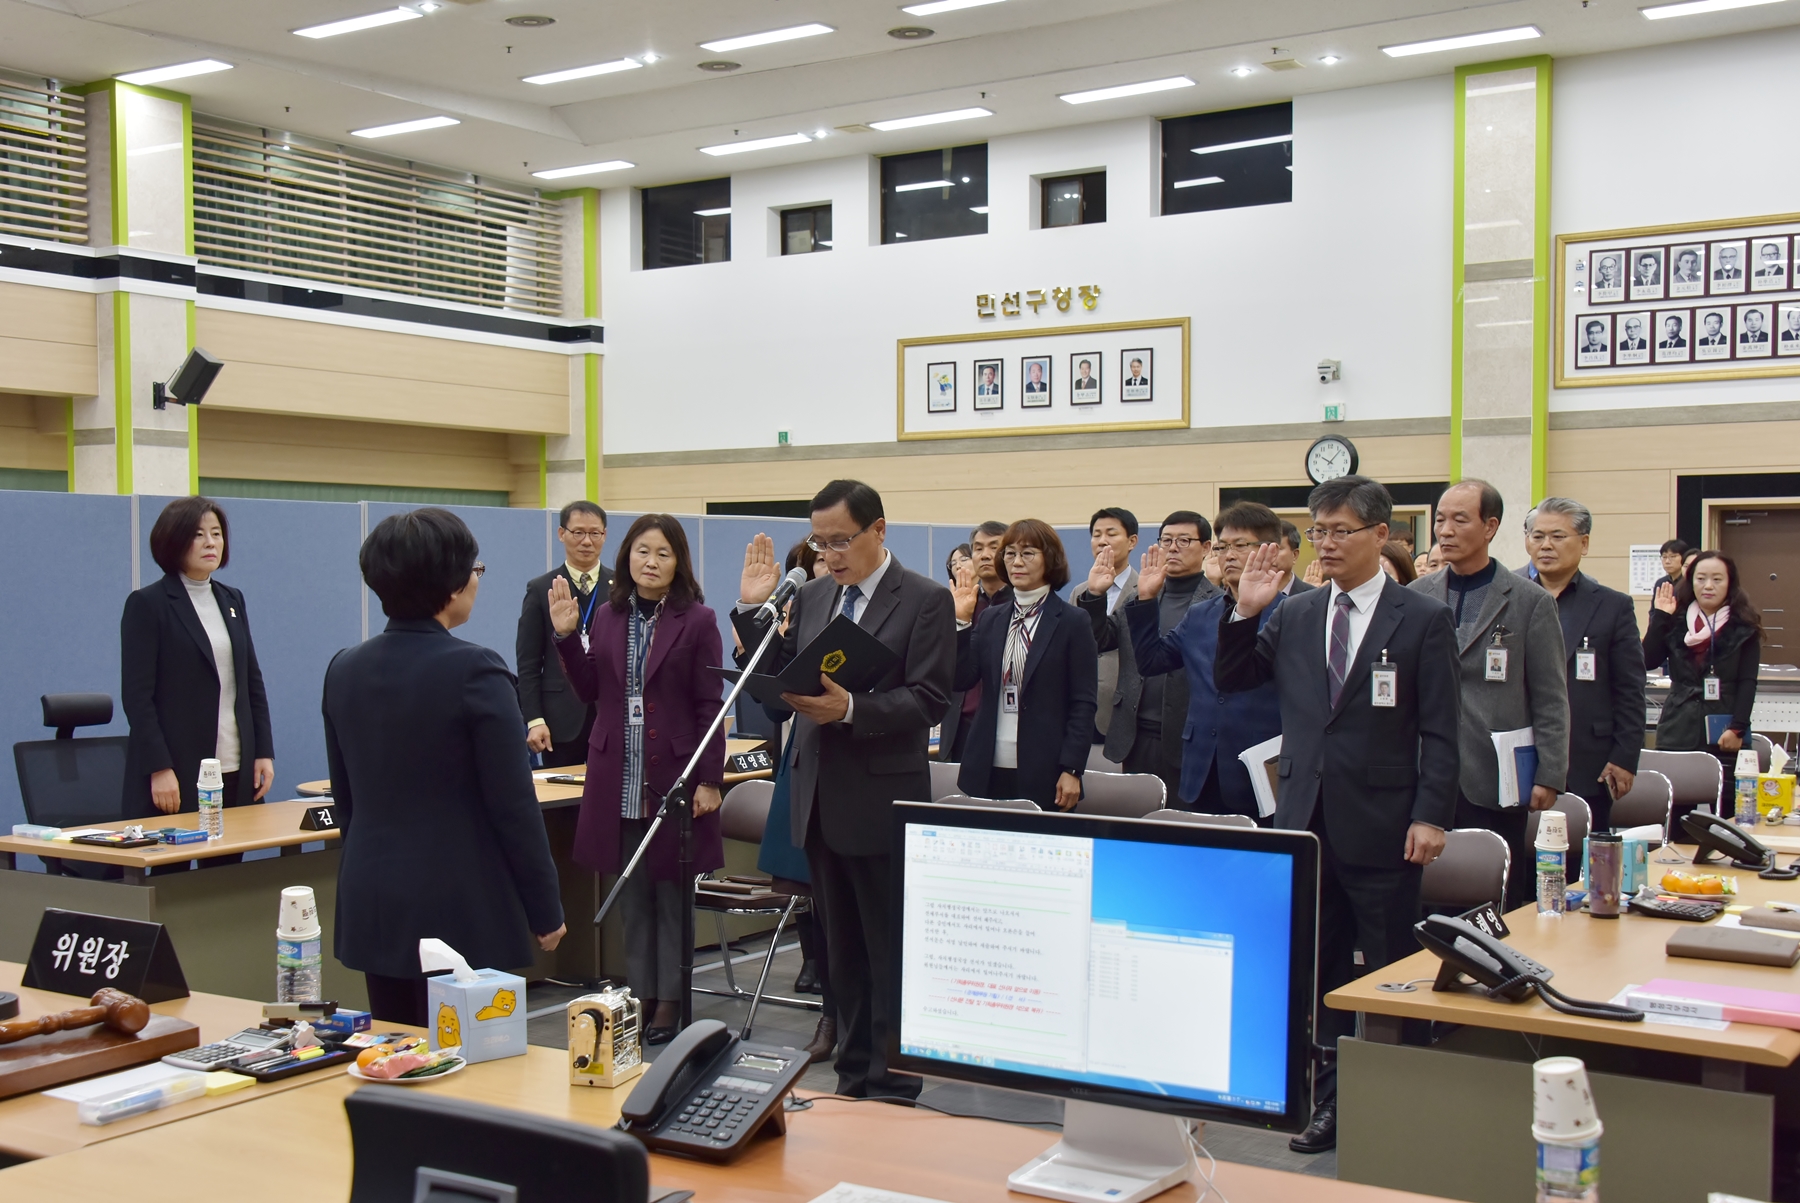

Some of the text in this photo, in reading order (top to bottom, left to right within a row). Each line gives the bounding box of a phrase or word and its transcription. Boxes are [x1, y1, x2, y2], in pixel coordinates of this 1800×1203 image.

[976, 285, 1102, 318] 민선구청장
[737, 754, 768, 769] 김영관
[52, 932, 130, 980] 위원장
